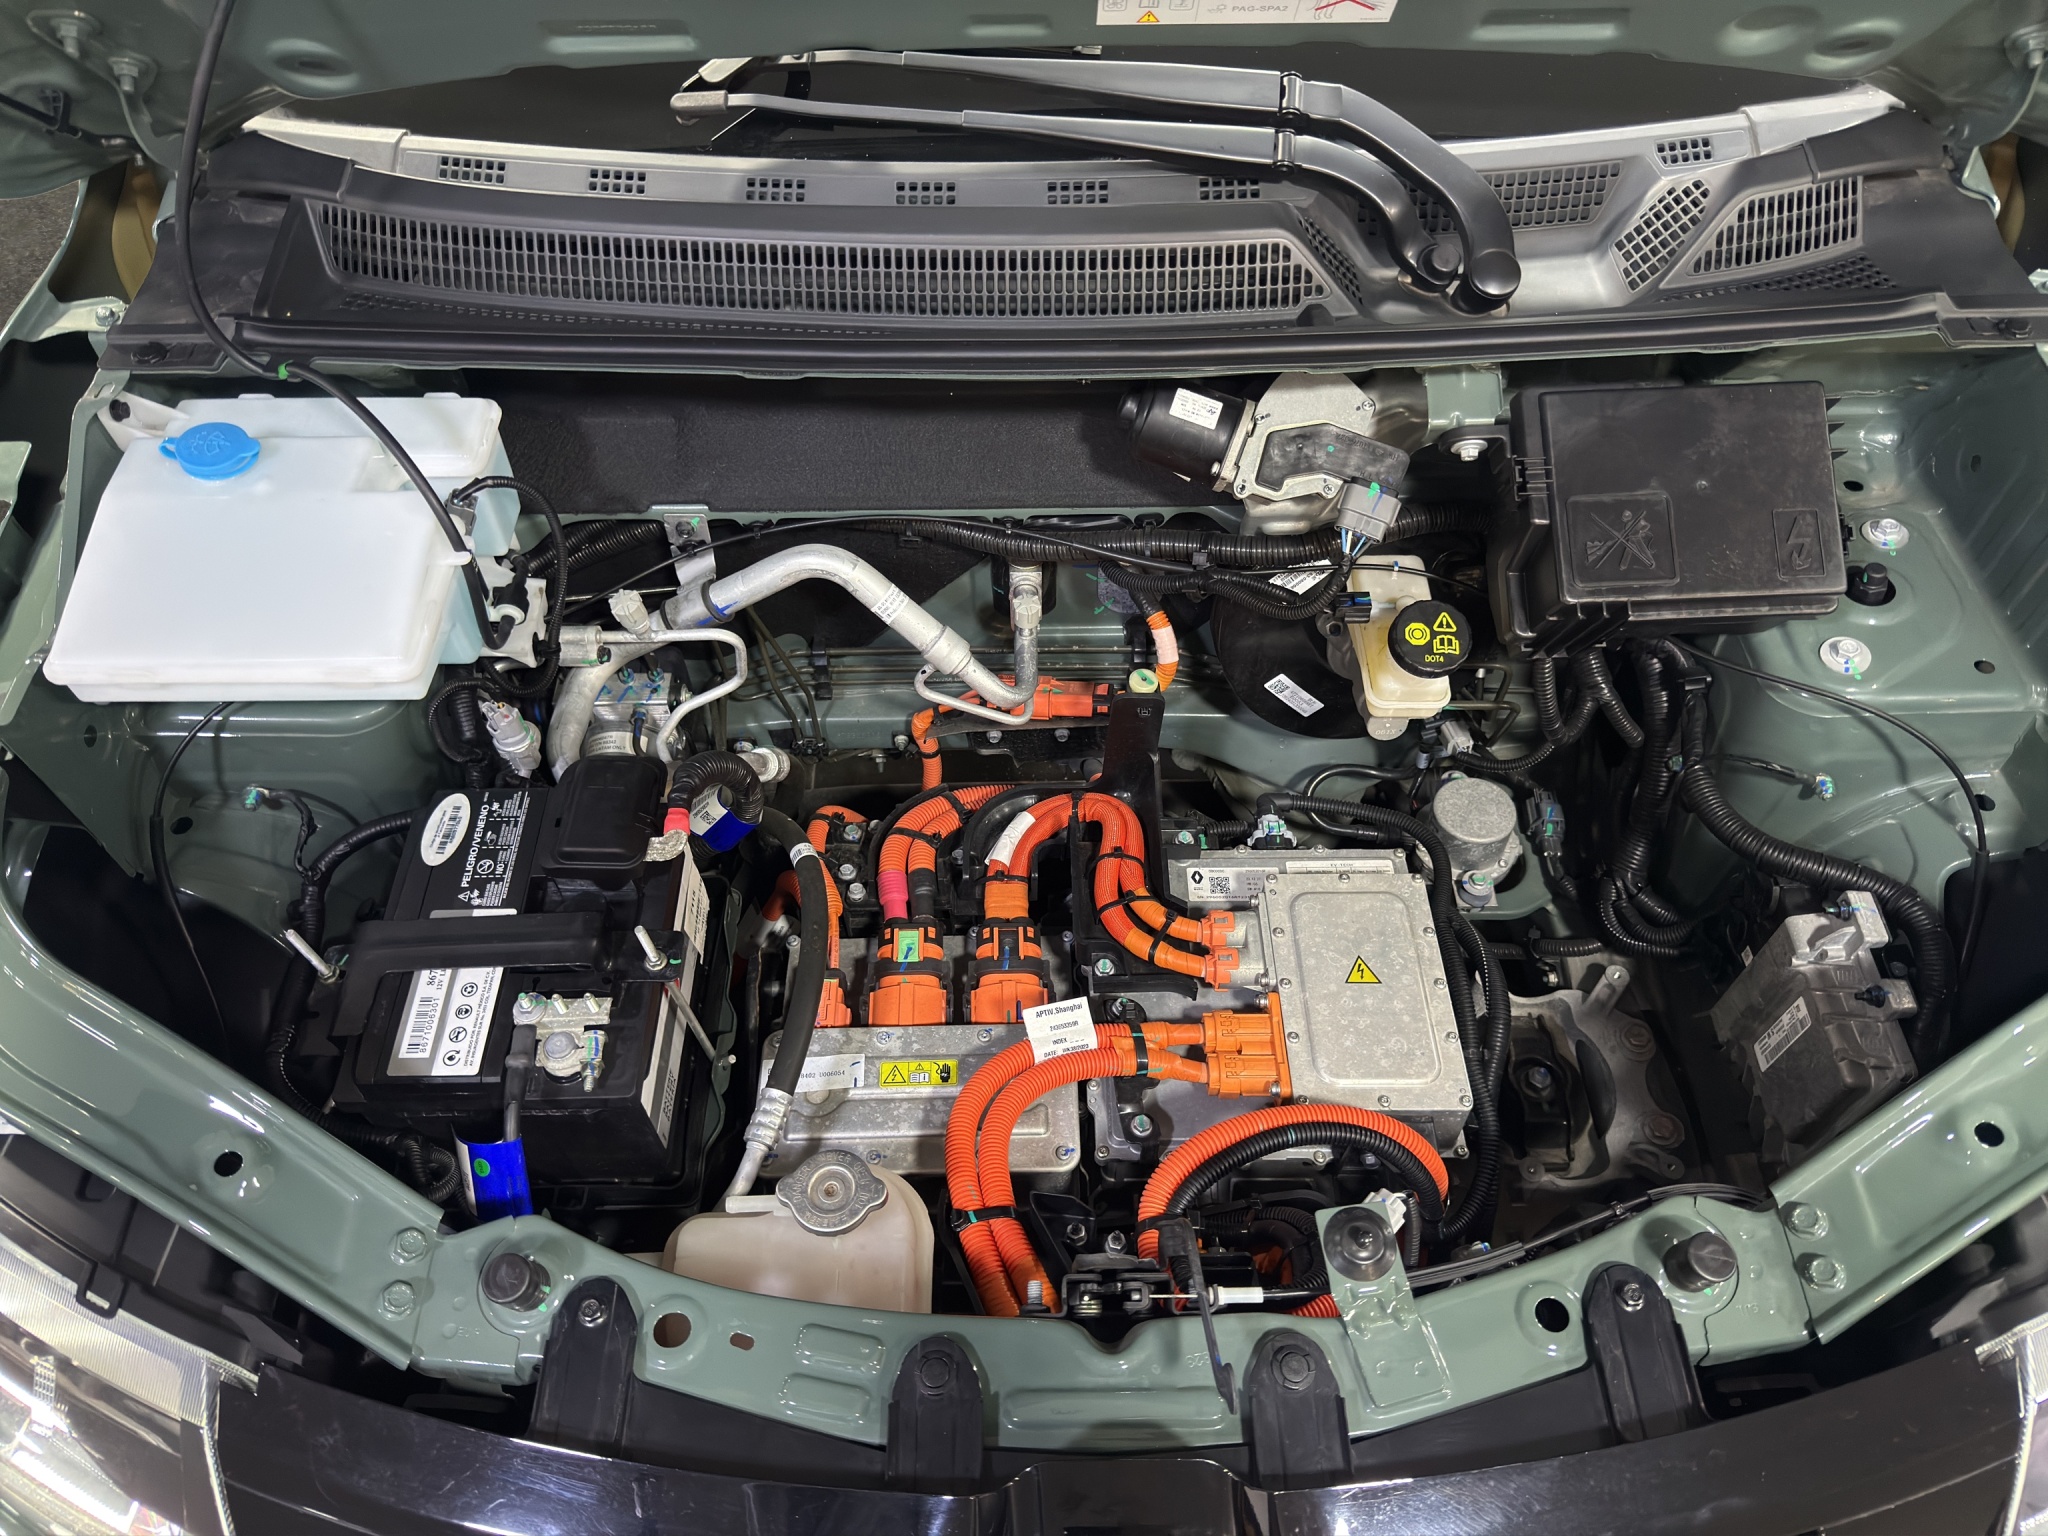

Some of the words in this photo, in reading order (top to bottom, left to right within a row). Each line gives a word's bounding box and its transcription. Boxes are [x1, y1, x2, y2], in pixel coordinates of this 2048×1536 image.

[1424, 654, 1444, 663] DOT4
[461, 804, 490, 887] PELIGRO/VENENO
[420, 998, 440, 1053] 8671006301
[792, 1165, 811, 1203] DANGER
[820, 1152, 852, 1163] NEVER
